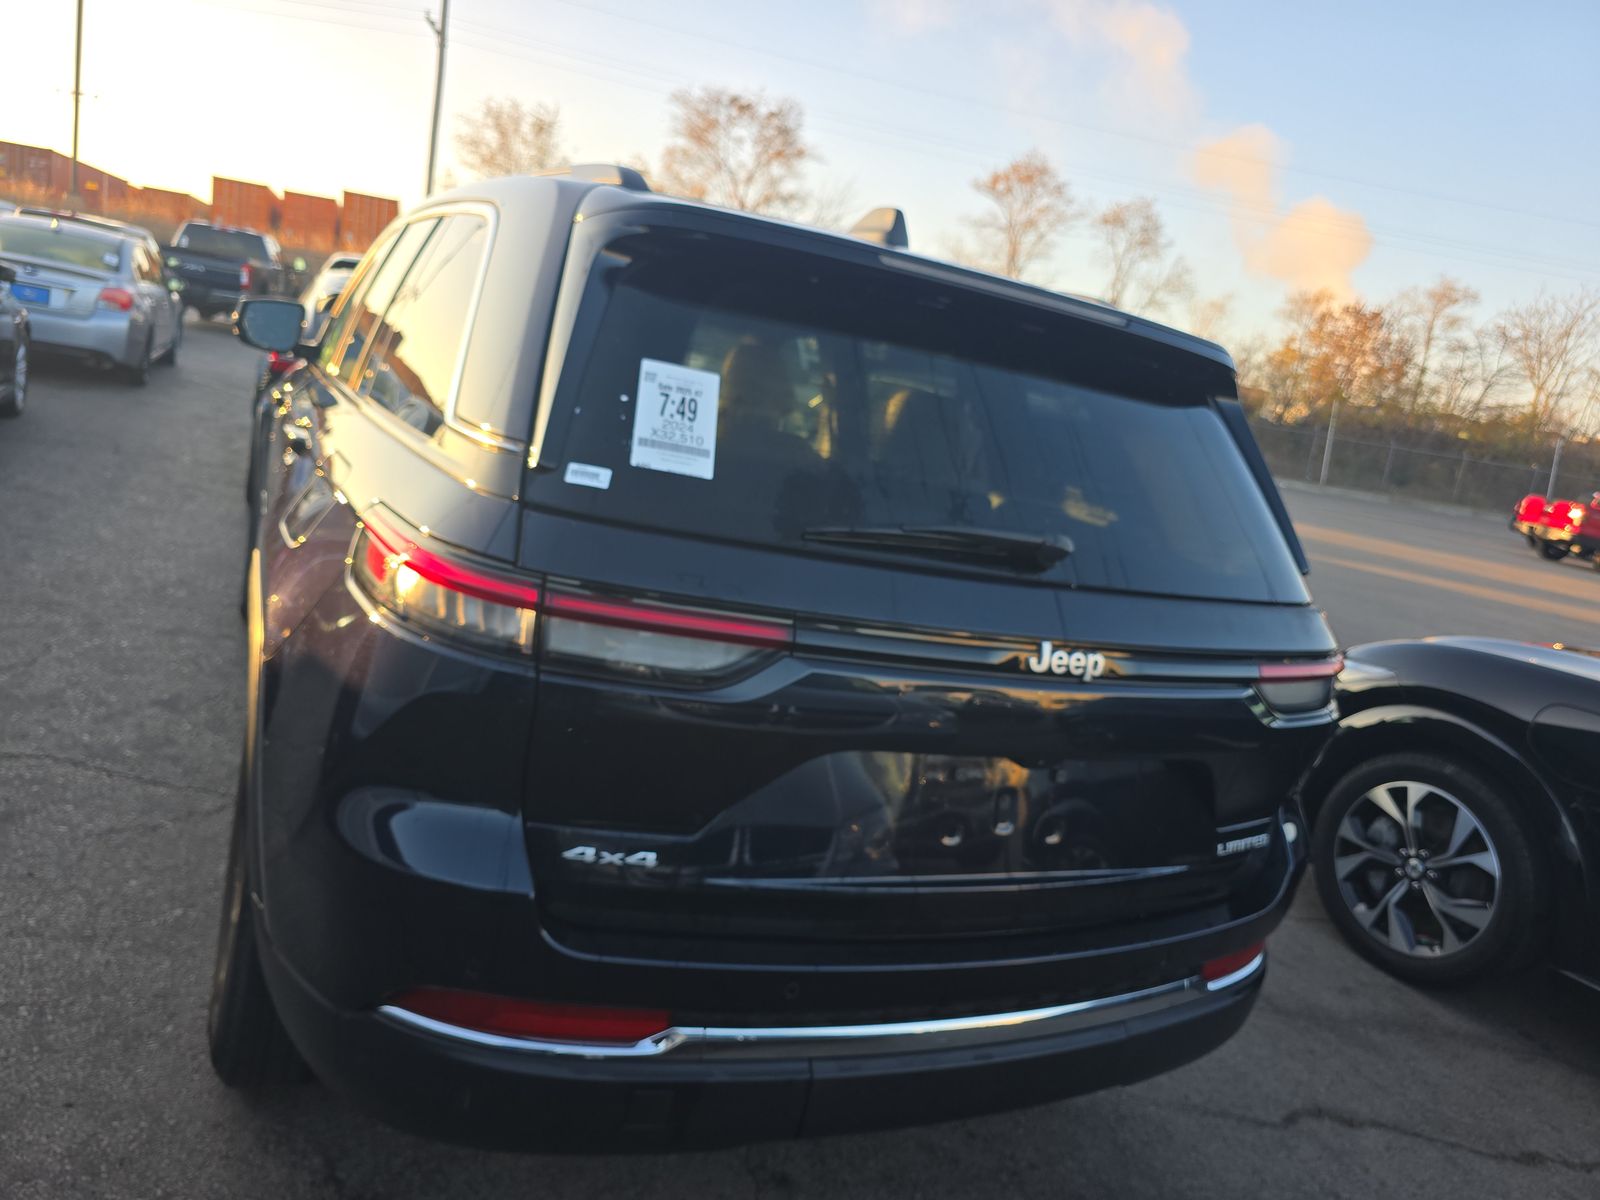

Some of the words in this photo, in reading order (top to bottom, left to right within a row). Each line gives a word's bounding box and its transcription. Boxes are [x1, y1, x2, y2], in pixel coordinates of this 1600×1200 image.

[659, 392, 698, 423] 7:49
[1028, 640, 1105, 682] Jeep
[561, 845, 658, 868] 4x4
[1216, 833, 1270, 857] LIMITED
